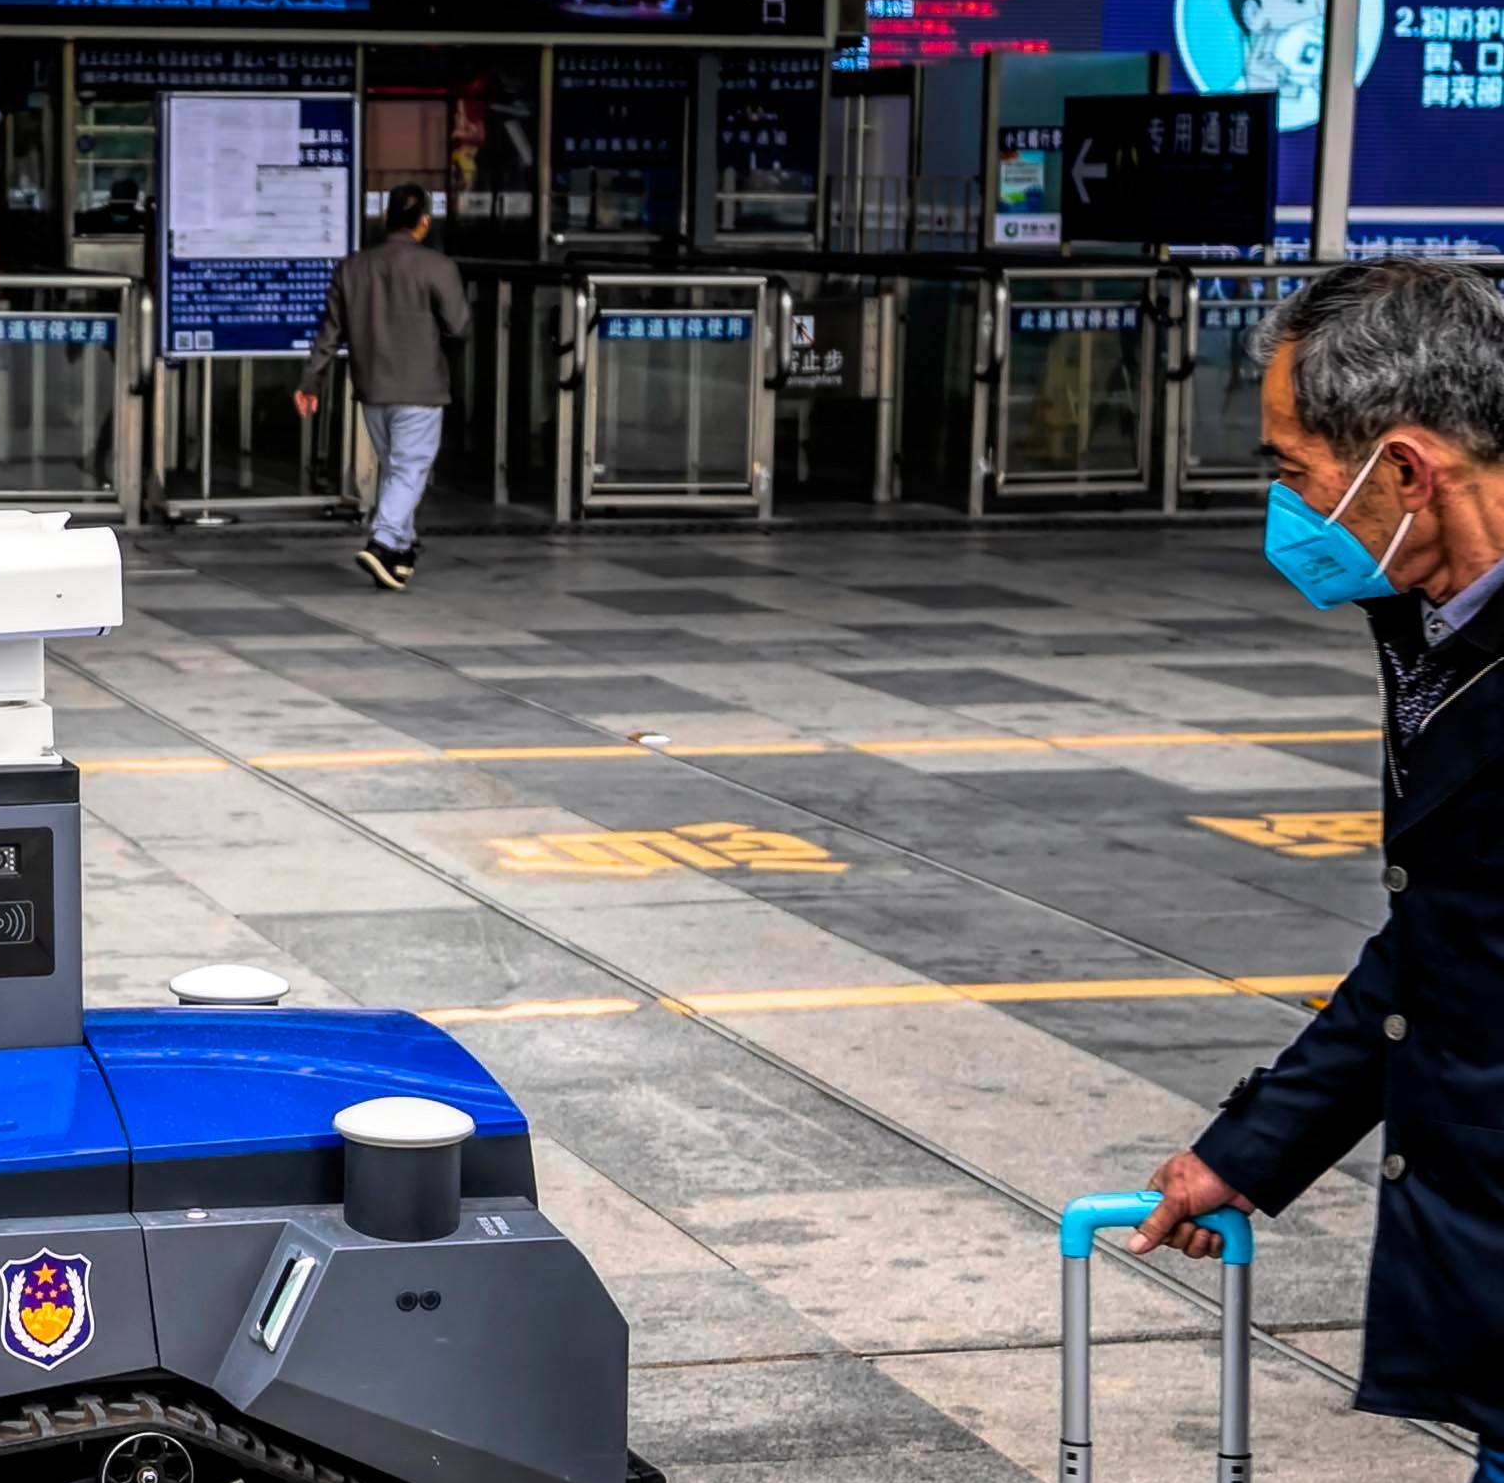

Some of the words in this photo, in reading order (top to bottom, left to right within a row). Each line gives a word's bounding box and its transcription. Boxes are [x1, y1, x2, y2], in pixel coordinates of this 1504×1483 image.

[1146, 110, 1251, 157] 专用通道
[607, 316, 743, 338] 此通道暂停使用
[1018, 307, 1139, 330] 此通道暂停使用
